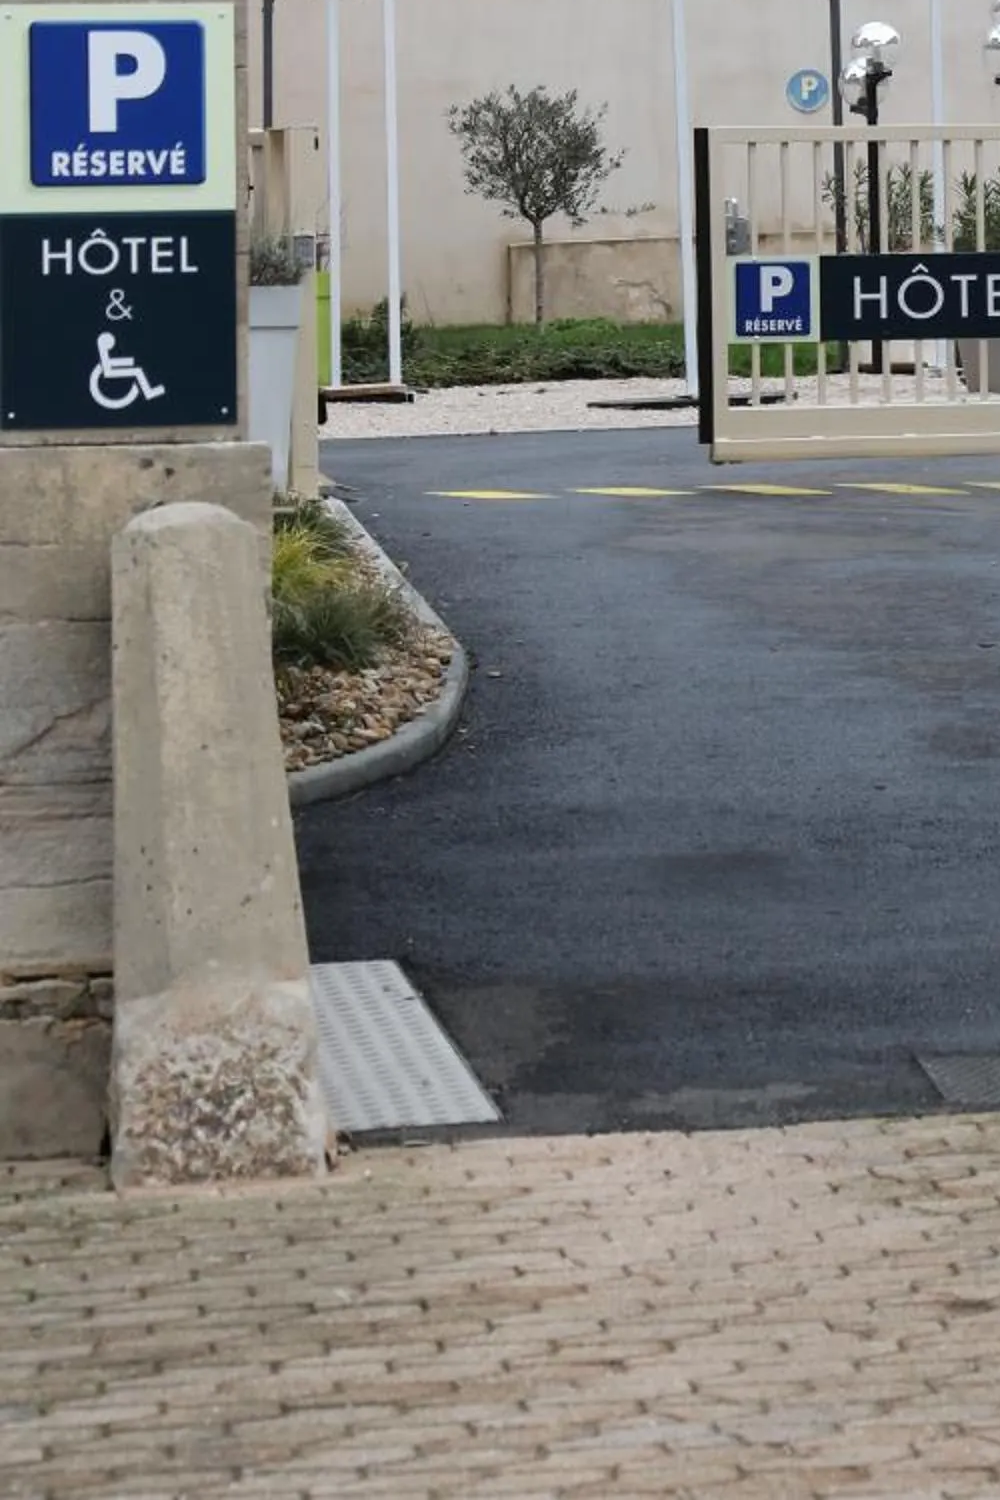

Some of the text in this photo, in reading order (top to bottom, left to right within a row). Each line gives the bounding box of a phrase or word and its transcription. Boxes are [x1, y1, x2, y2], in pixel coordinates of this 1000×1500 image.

[87, 30, 166, 133] P
[801, 75, 818, 100] P
[51, 142, 187, 177] RÉSERVÉ
[41, 228, 198, 276] HÔTEL
[105, 288, 133, 321] &
[759, 265, 794, 312] P
[745, 316, 803, 333] RÉSERVÉ
